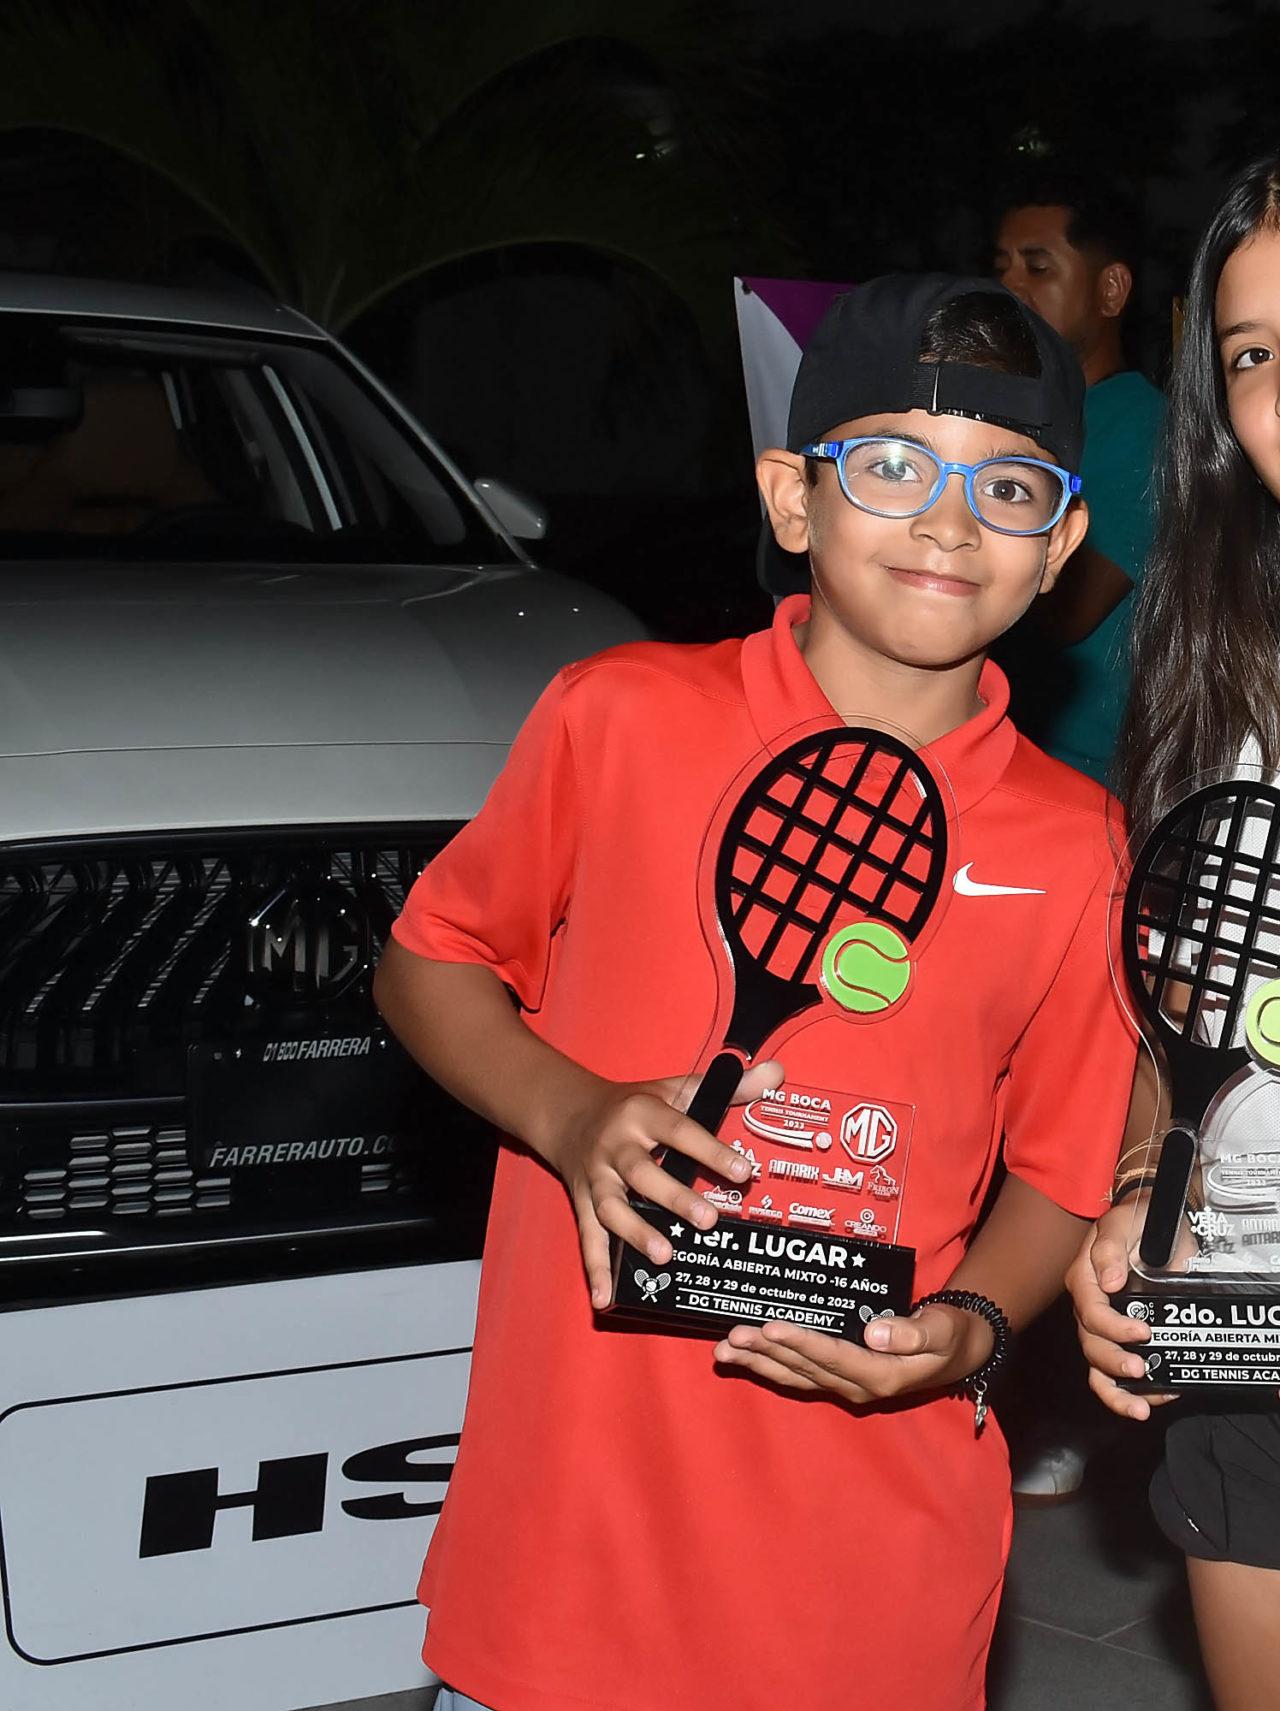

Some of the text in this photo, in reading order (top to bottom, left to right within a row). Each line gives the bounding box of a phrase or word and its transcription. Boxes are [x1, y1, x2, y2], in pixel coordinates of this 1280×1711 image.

[297, 1036, 371, 1060] FARRERA
[762, 1088, 831, 1111] MG BOCA
[846, 1108, 892, 1157] MG
[789, 1202, 836, 1220] Comex
[1188, 1211, 1229, 1225] VERA
[748, 1232, 849, 1269] LUGAR
[723, 1259, 781, 1278] ABIERTA
[784, 1268, 828, 1285] MIXTO
[829, 1275, 848, 1289] -16
[850, 1276, 889, 1296] AÑOS
[675, 1271, 857, 1311] 27, 28 y 29 de octubre de 2023
[688, 1293, 836, 1328] DG TENNIS ACADEMY
[1163, 1303, 1223, 1325] 2do.
[1152, 1330, 1202, 1343] EGORÍA
[1205, 1333, 1262, 1344] ABIERTA
[1164, 1350, 1181, 1362] 27,
[1183, 1350, 1197, 1361] 28
[1199, 1353, 1206, 1363] y
[1208, 1351, 1222, 1362] 29
[1225, 1351, 1240, 1362] de
[1181, 1368, 1200, 1380] DG
[1204, 1368, 1250, 1381] TENNIS
